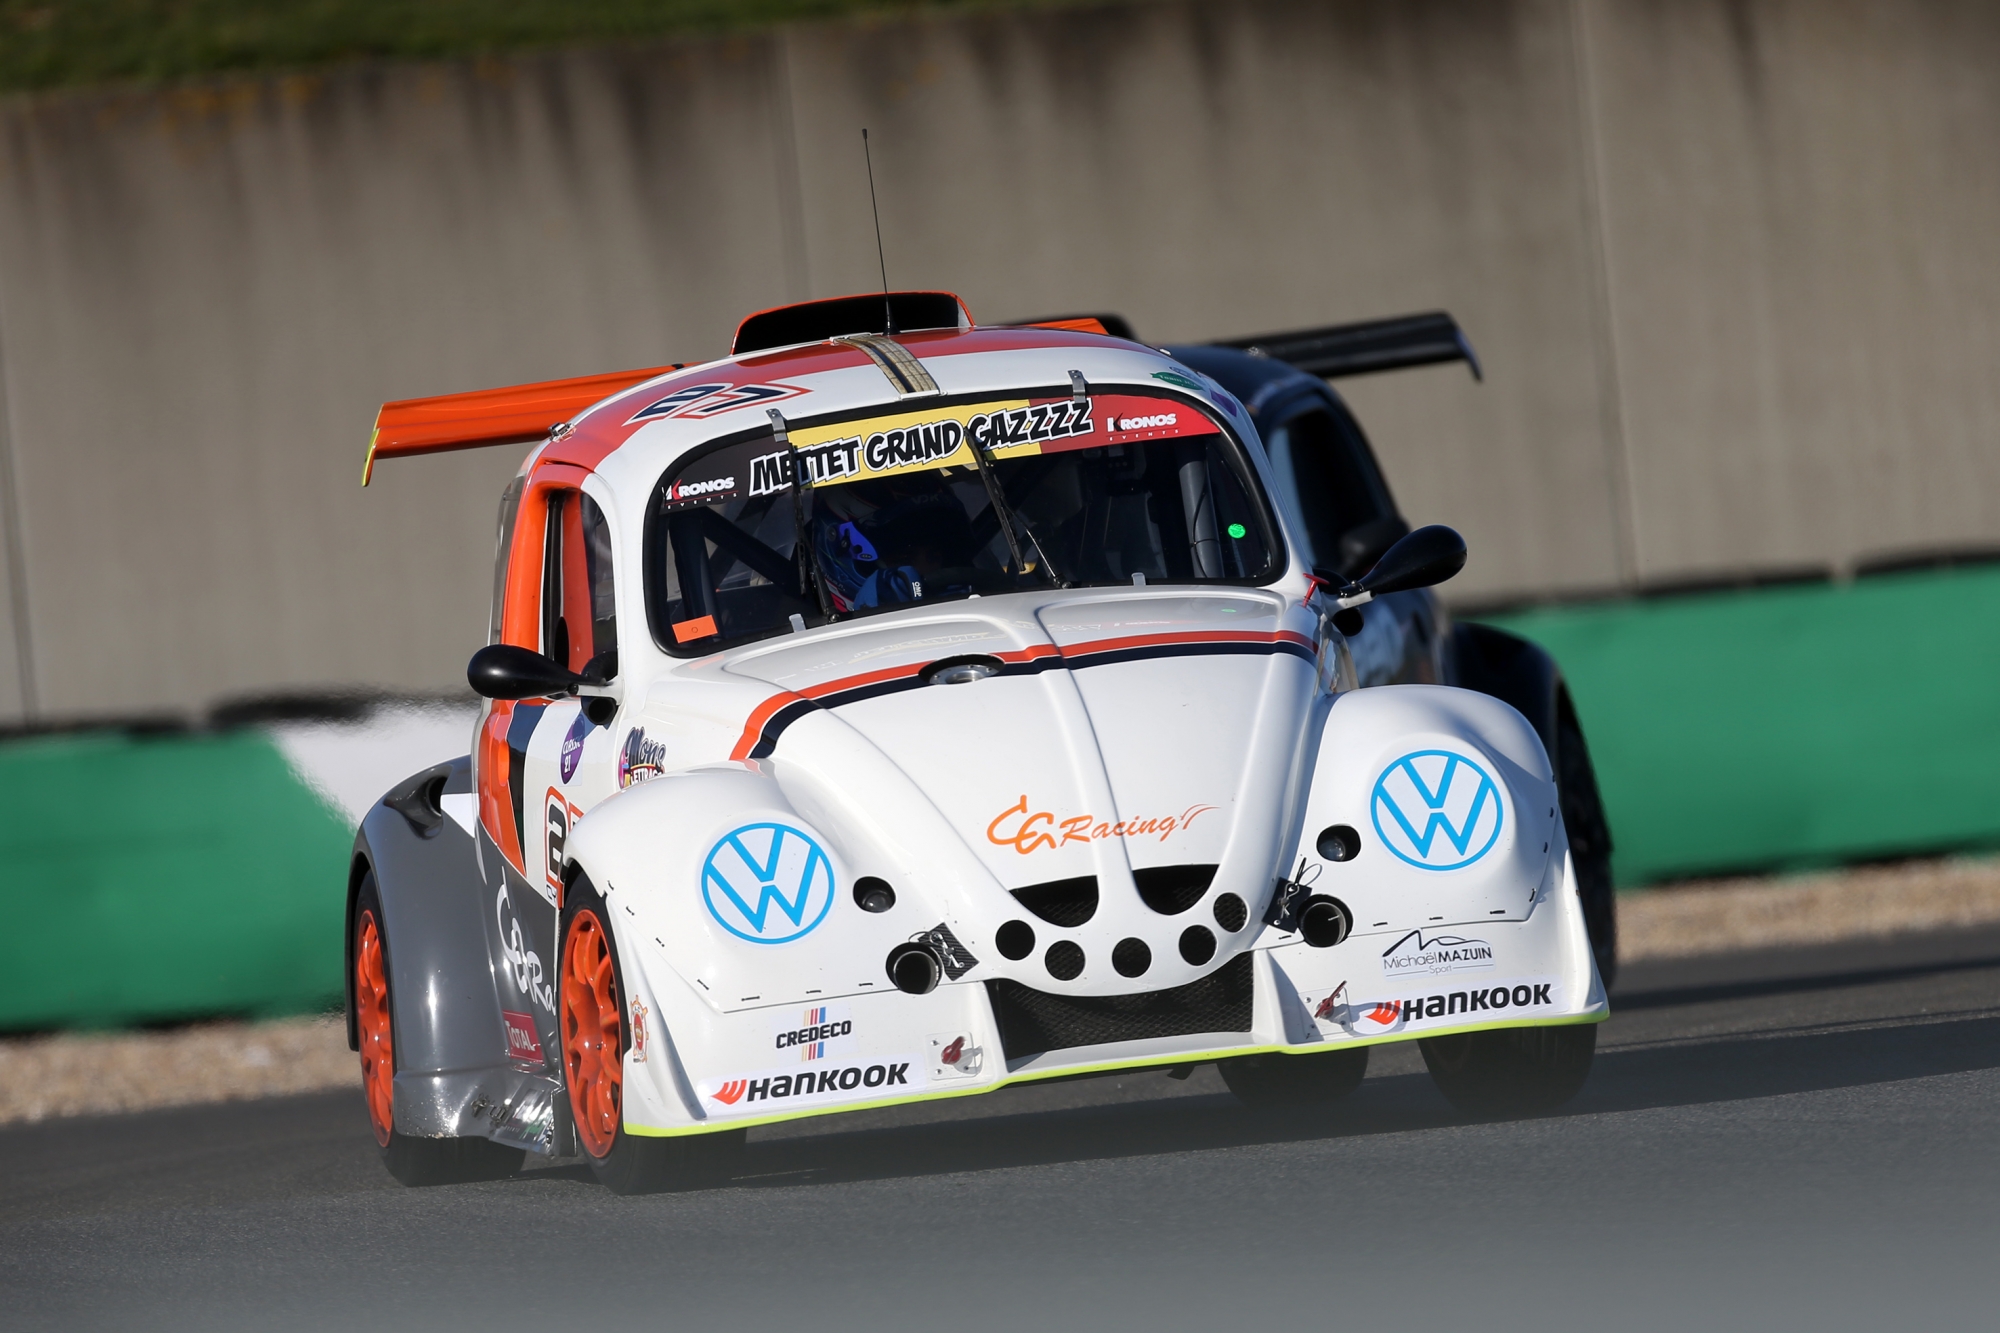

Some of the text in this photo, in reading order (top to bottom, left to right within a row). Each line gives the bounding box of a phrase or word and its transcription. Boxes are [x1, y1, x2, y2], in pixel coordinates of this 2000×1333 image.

[624, 382, 803, 420] 27
[1106, 413, 1177, 433] KRONOS
[1109, 429, 1180, 441] EVENTS
[750, 398, 1095, 497] METTET GRAND GAZZZZ
[664, 477, 735, 501] KRONOS
[667, 492, 738, 510] EVENTS
[912, 581, 922, 598] OMP
[564, 754, 572, 773] 21
[1059, 813, 1180, 848] Racing
[1428, 964, 1453, 976] Sport
[505, 1020, 537, 1052] TOTAL
[776, 1020, 852, 1049] CREDECO
